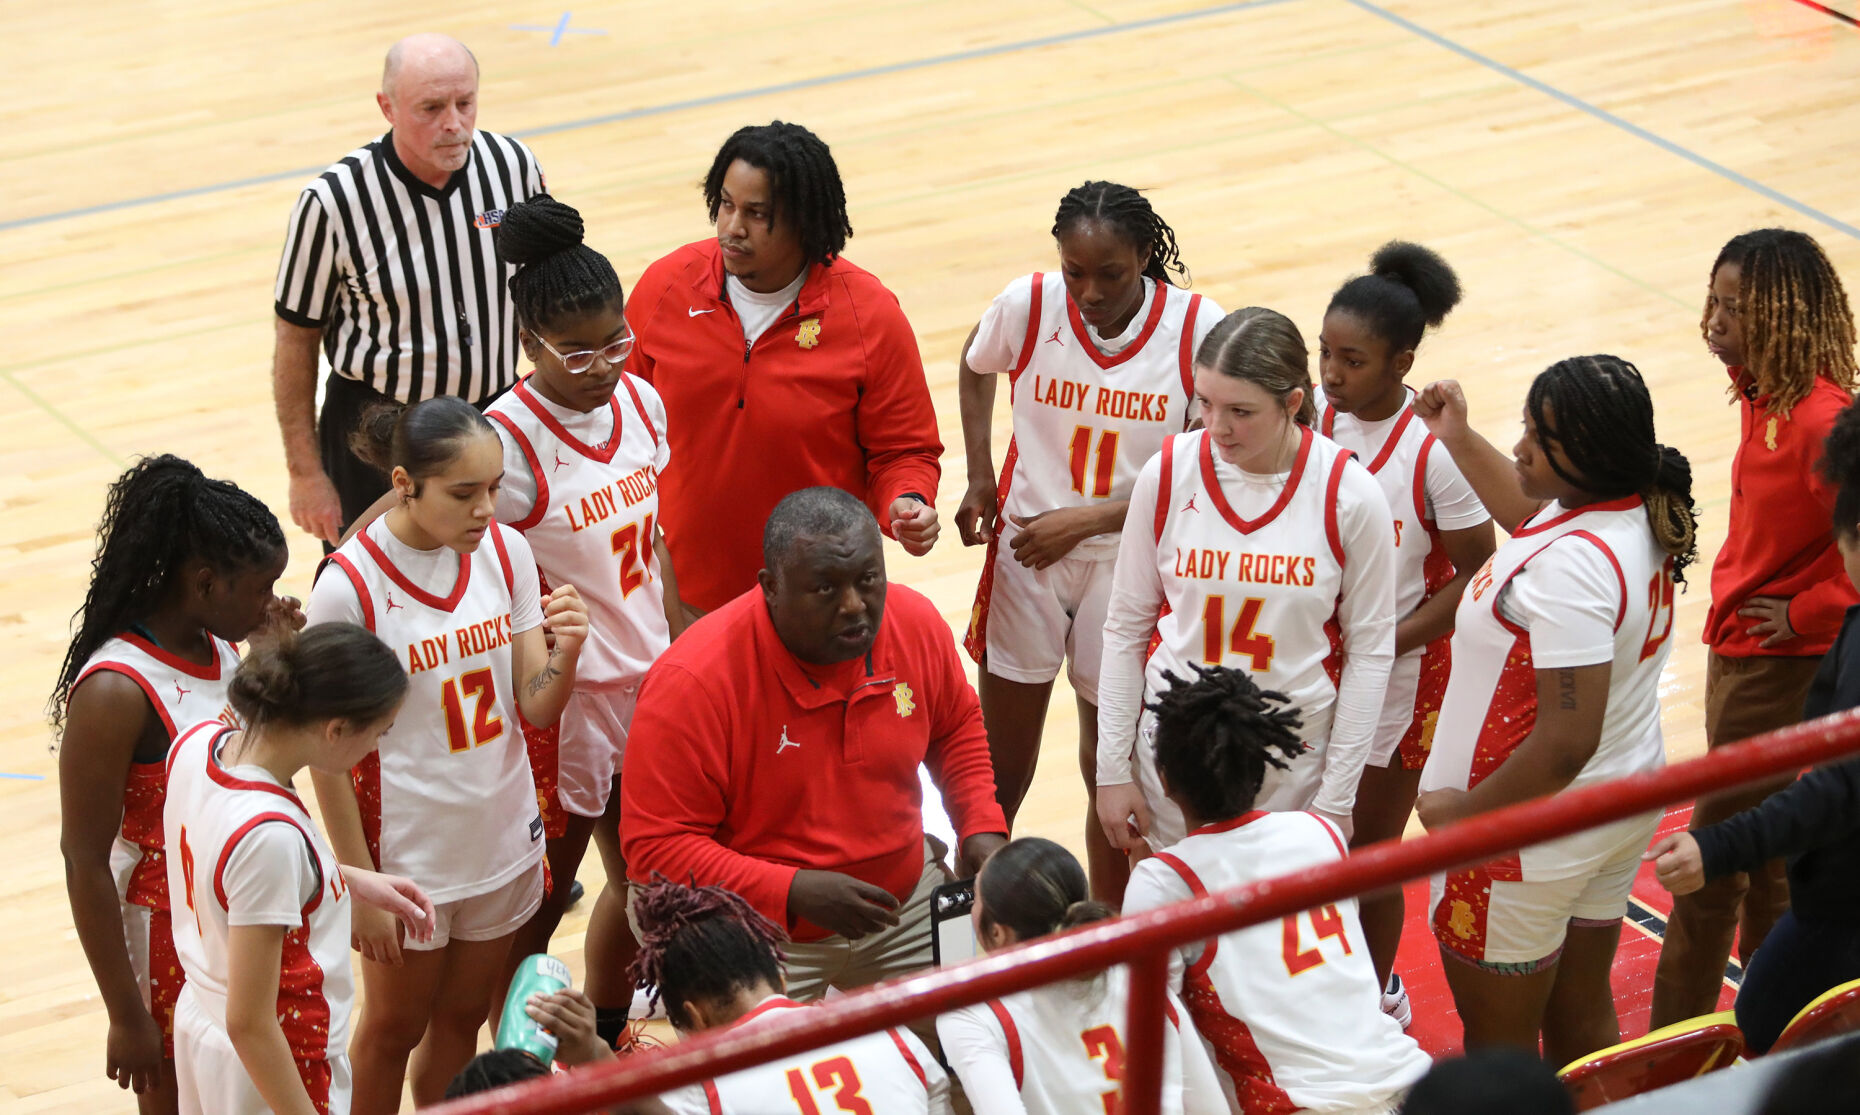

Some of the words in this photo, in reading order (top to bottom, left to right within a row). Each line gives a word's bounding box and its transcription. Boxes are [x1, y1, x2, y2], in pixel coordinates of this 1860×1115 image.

[1034, 374, 1090, 411] LADY
[1096, 387, 1169, 422] ROCKS
[1068, 424, 1120, 498] 11
[564, 484, 617, 533] LADY
[610, 511, 654, 601] 21
[1175, 547, 1231, 581] LADY
[1238, 553, 1316, 587] ROCKS
[407, 633, 449, 676] ADY
[455, 612, 512, 659] ROCKS
[1201, 594, 1276, 672] 14
[441, 665, 504, 754] 12
[784, 1055, 875, 1115] 13
